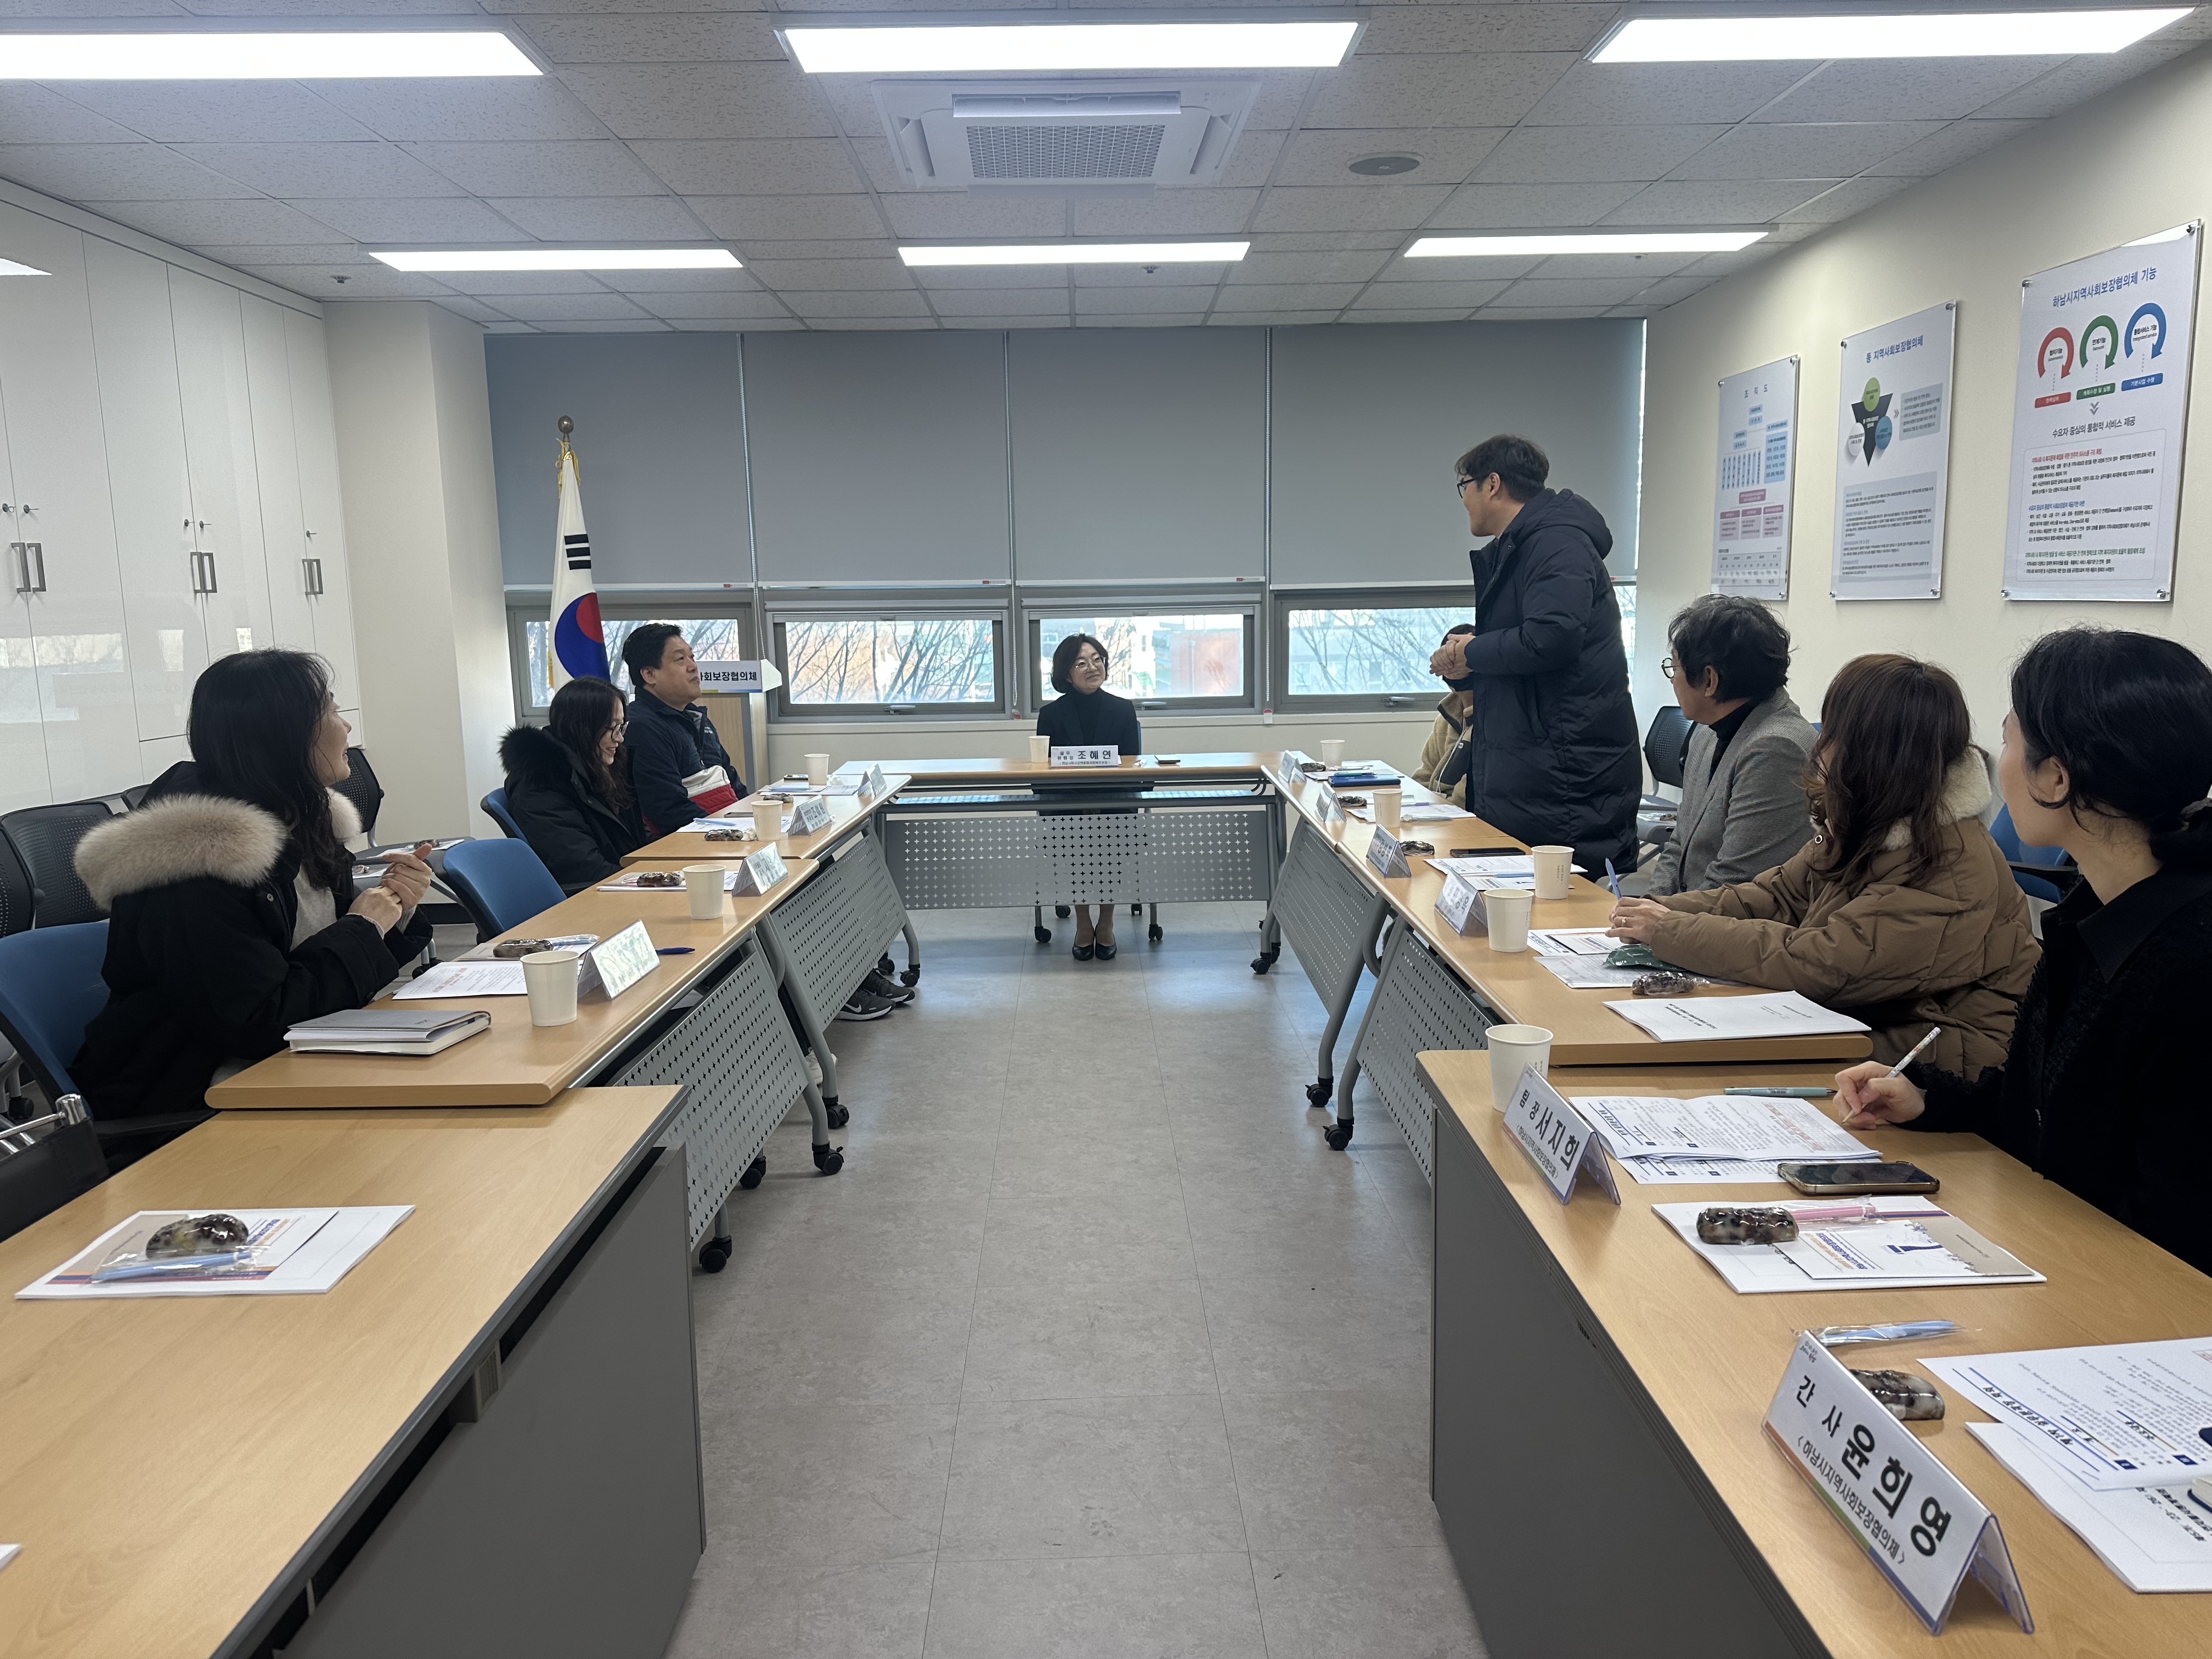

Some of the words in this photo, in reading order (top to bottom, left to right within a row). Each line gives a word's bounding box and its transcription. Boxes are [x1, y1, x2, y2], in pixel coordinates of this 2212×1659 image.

[2053, 271, 2138, 307] 하남시지역사회보장협의체
[2141, 267, 2157, 281] 기능
[1866, 352, 1872, 363] 동
[1873, 335, 1923, 360] 지역사회보장협의체
[2052, 427, 2069, 438] 수요자
[2069, 424, 2086, 435] 중심의
[2087, 421, 2104, 433] 통합적
[2105, 419, 2122, 429] 서비스
[2124, 416, 2136, 426] 제공
[1535, 1106, 1580, 1171] 서지희
[1841, 1424, 1951, 1557] 윤희영
